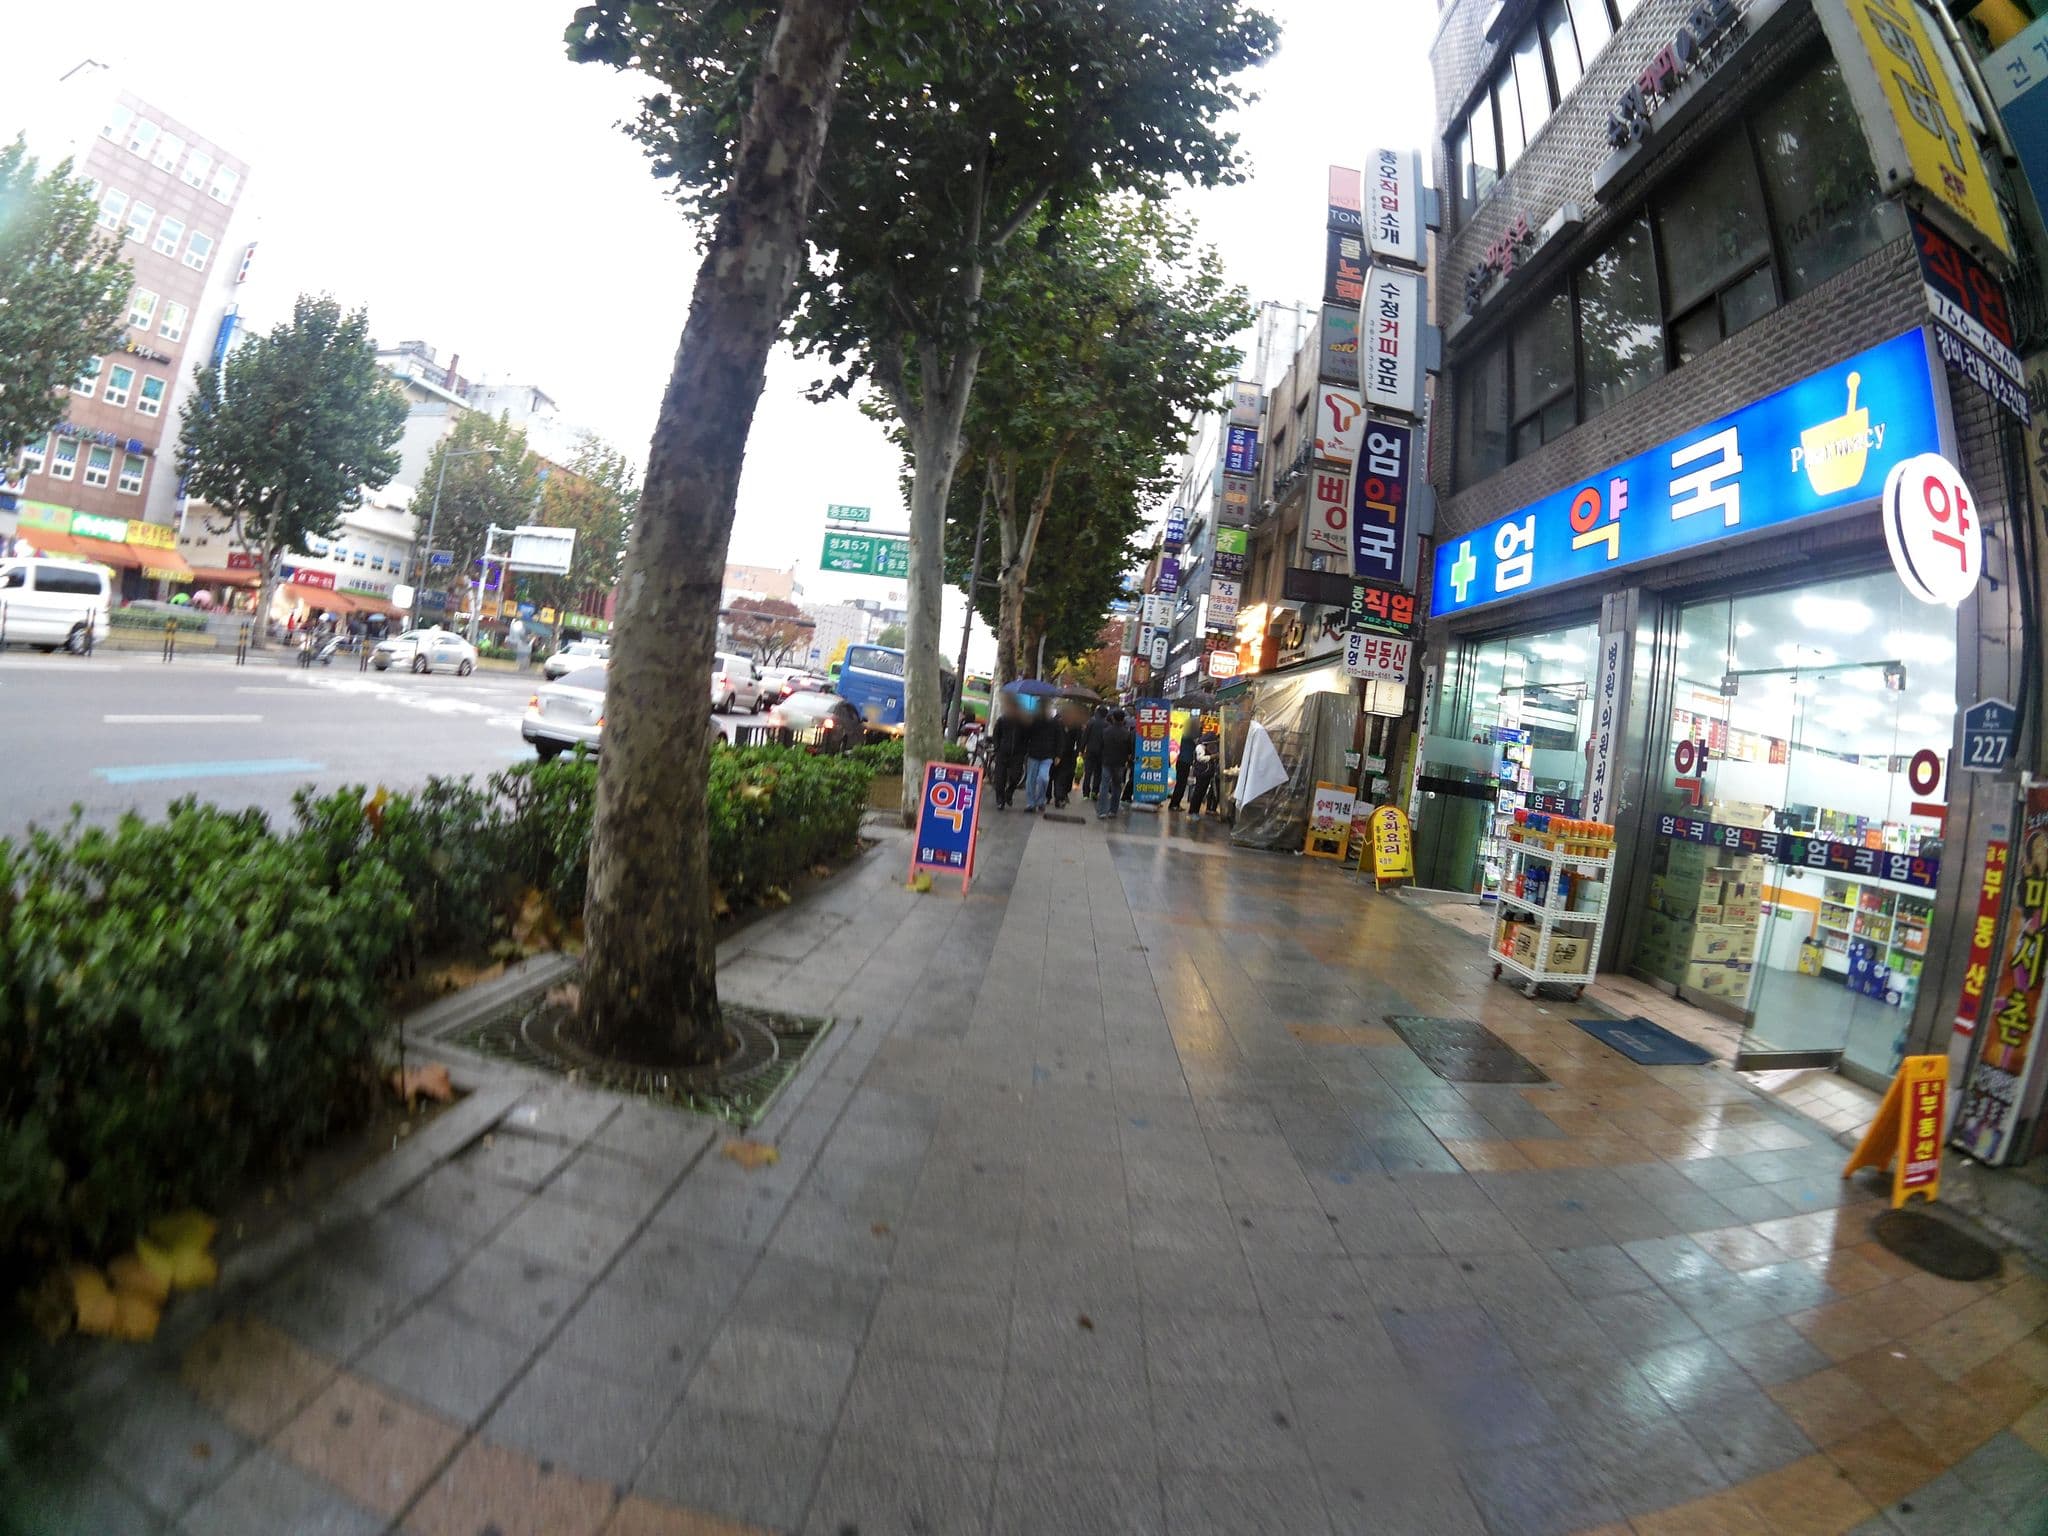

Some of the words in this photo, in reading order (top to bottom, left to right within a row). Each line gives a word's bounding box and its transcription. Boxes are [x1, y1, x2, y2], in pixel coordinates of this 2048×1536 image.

[1377, 282, 1400, 394] 수정커피호프
[1934, 291, 2020, 380] 766-6540
[1790, 420, 1886, 473] Pharmacy
[1360, 432, 1402, 571] 엄약국
[1922, 474, 1970, 573] 약
[829, 538, 870, 552] 청계5가
[1363, 587, 1416, 625] 직업
[1363, 639, 1407, 672] 부동산
[1139, 708, 1168, 724] 로또
[1141, 724, 1166, 739] 1등
[1141, 756, 1162, 769] 2등
[1142, 740, 1162, 752] 8번
[1970, 735, 2008, 764] 227
[1672, 738, 1709, 807] 약
[930, 781, 974, 833] 약
[1662, 816, 1704, 841] 엄약국
[1724, 826, 1779, 856] 엄약국
[1807, 840, 1874, 874] 엄약국
[1964, 868, 2003, 997] 부동산
[1914, 1095, 1938, 1161] 부동산
